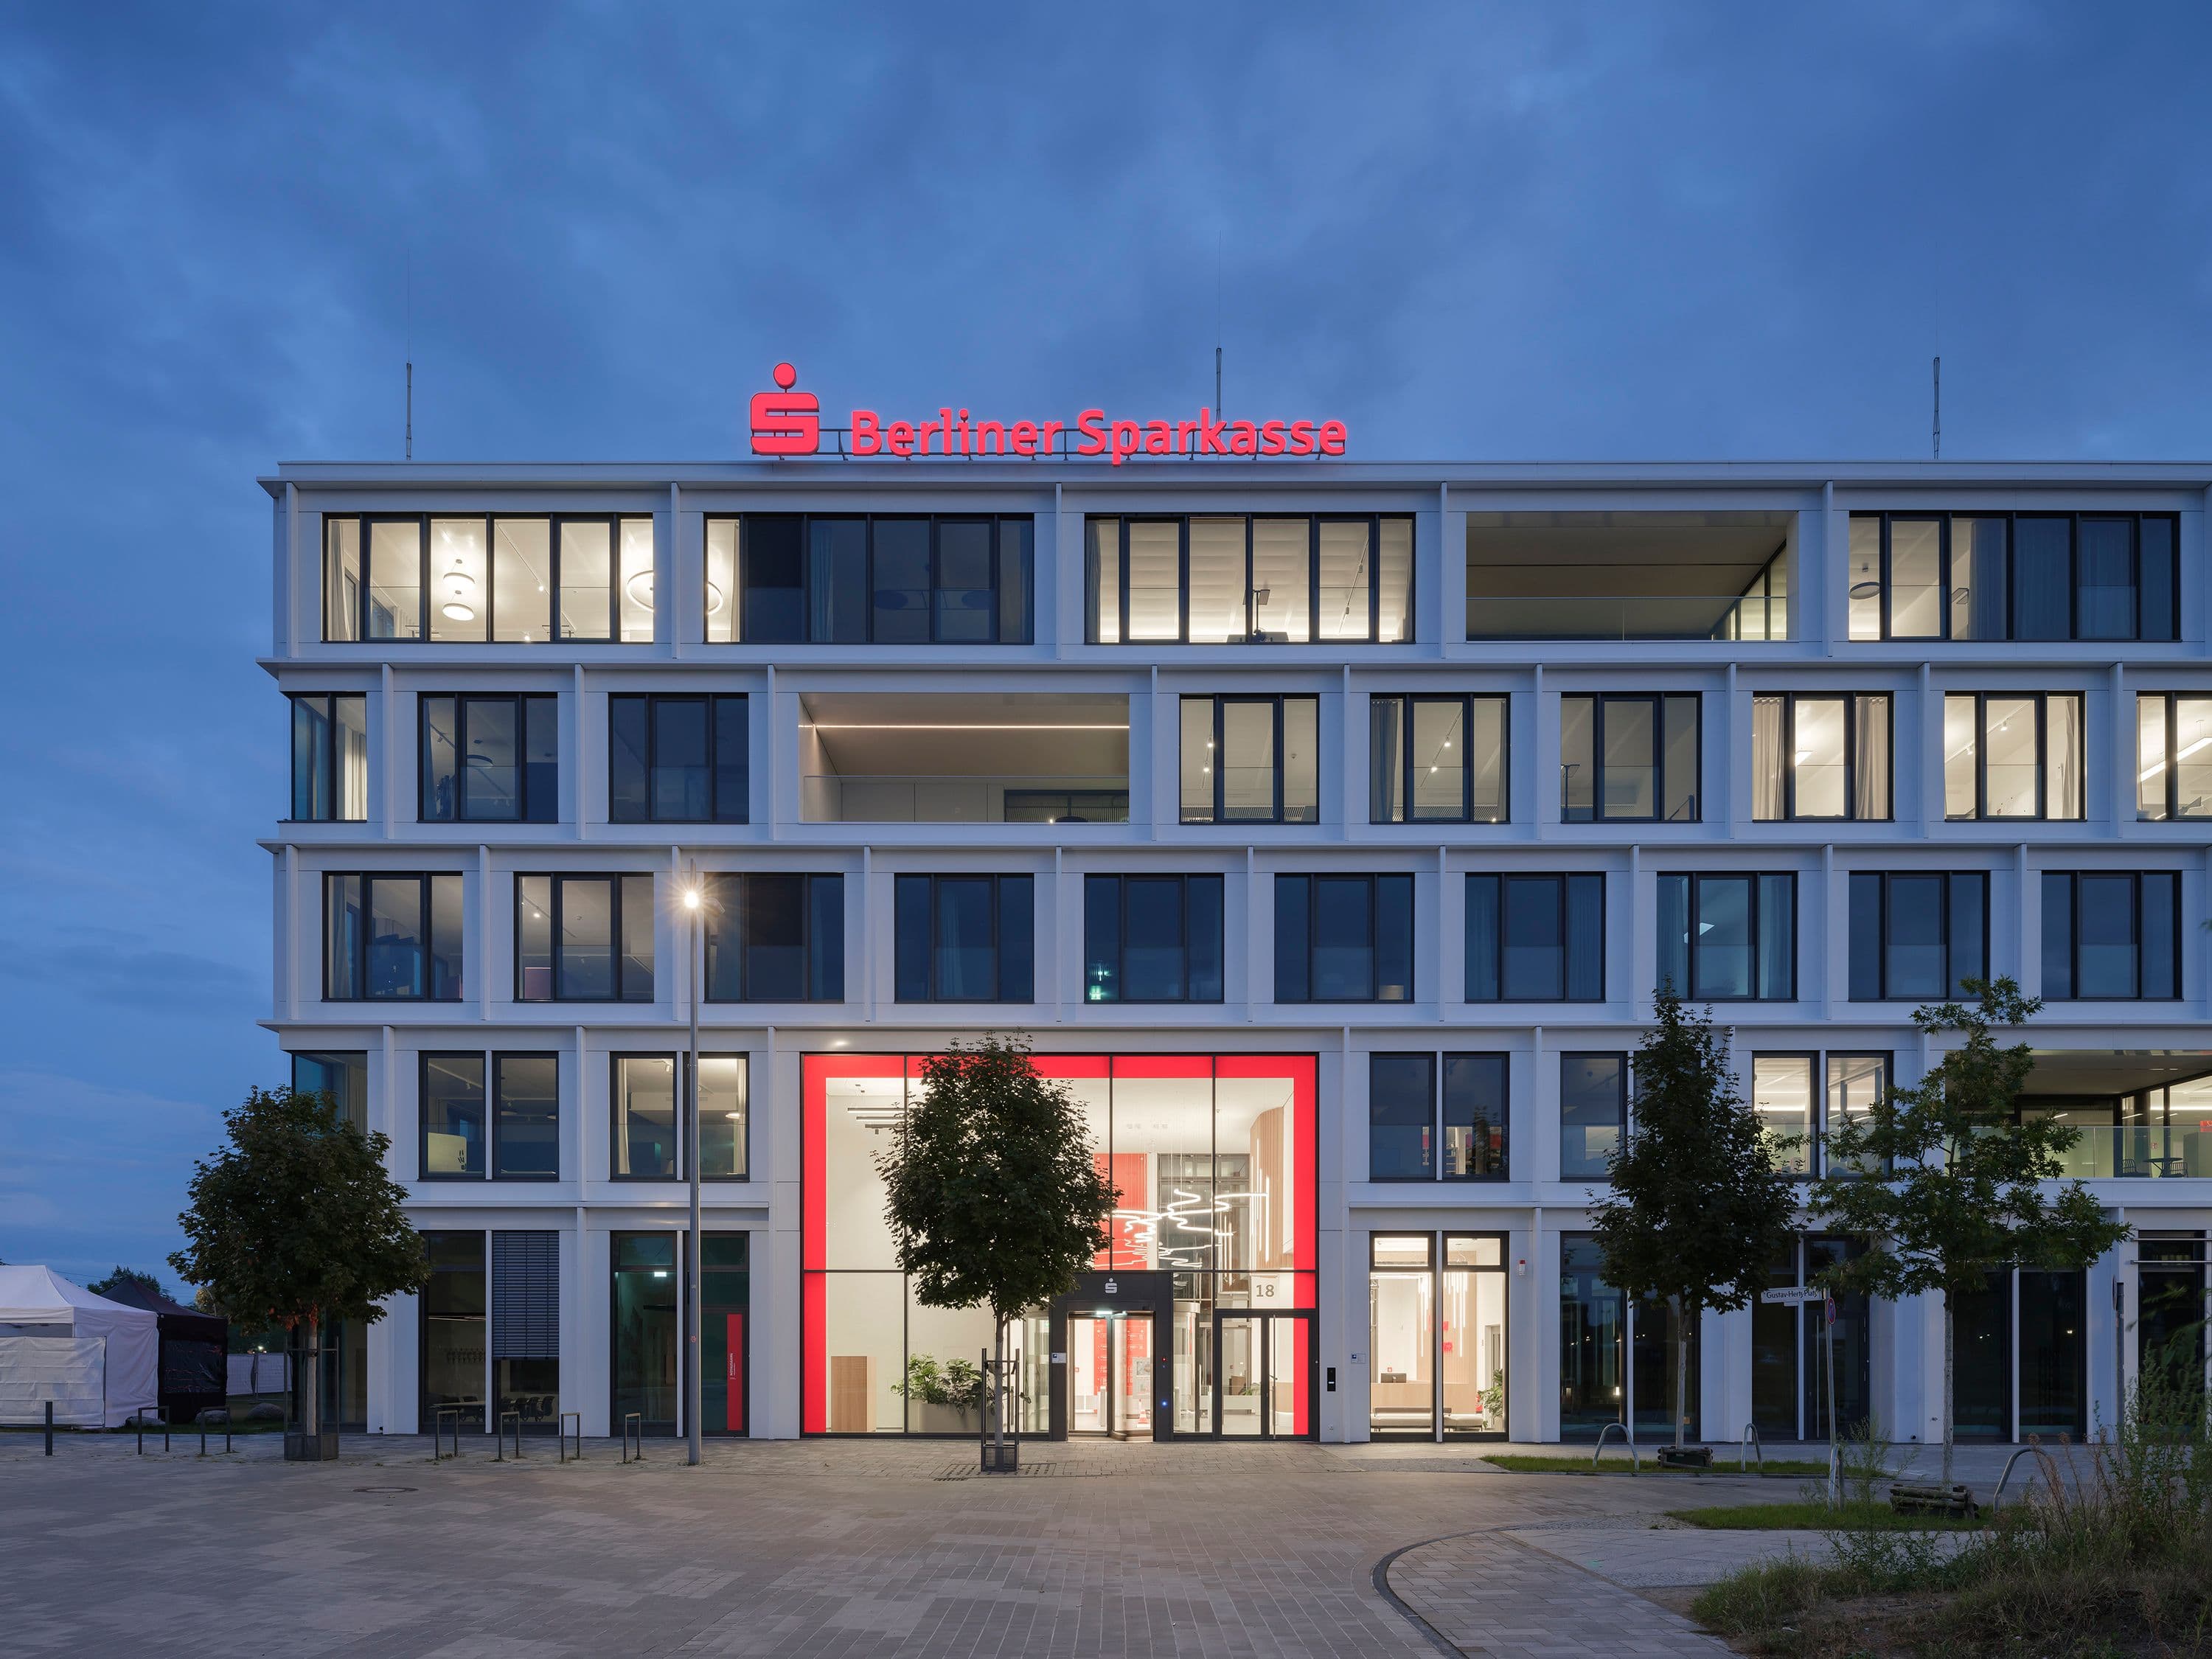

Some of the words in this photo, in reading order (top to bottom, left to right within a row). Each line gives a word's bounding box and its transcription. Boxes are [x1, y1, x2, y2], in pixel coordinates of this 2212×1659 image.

[851, 408, 1062, 456] Berliner
[1077, 408, 1346, 466] Sparkasse
[1256, 1284, 1275, 1297] 18
